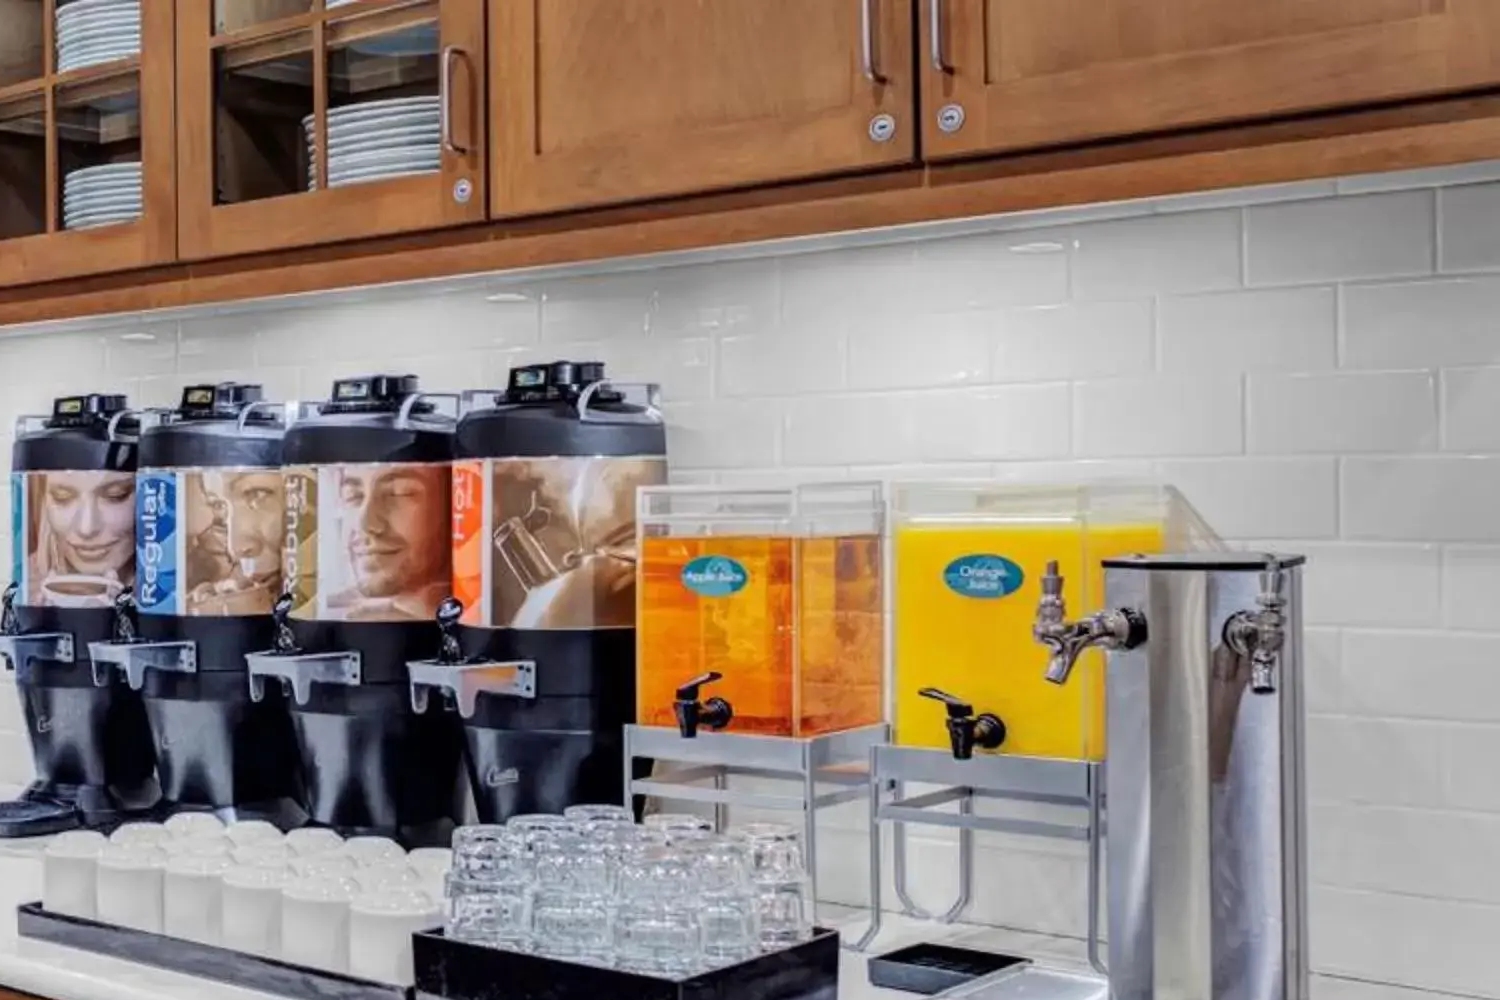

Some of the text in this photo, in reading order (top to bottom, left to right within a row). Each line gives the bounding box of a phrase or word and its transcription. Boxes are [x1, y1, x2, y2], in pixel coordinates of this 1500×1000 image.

[141, 482, 164, 604] Regular
[283, 475, 300, 600] Robust
[685, 571, 744, 584] Apple Juice
[960, 566, 1006, 580] Orange
[967, 580, 1000, 592] Juice
